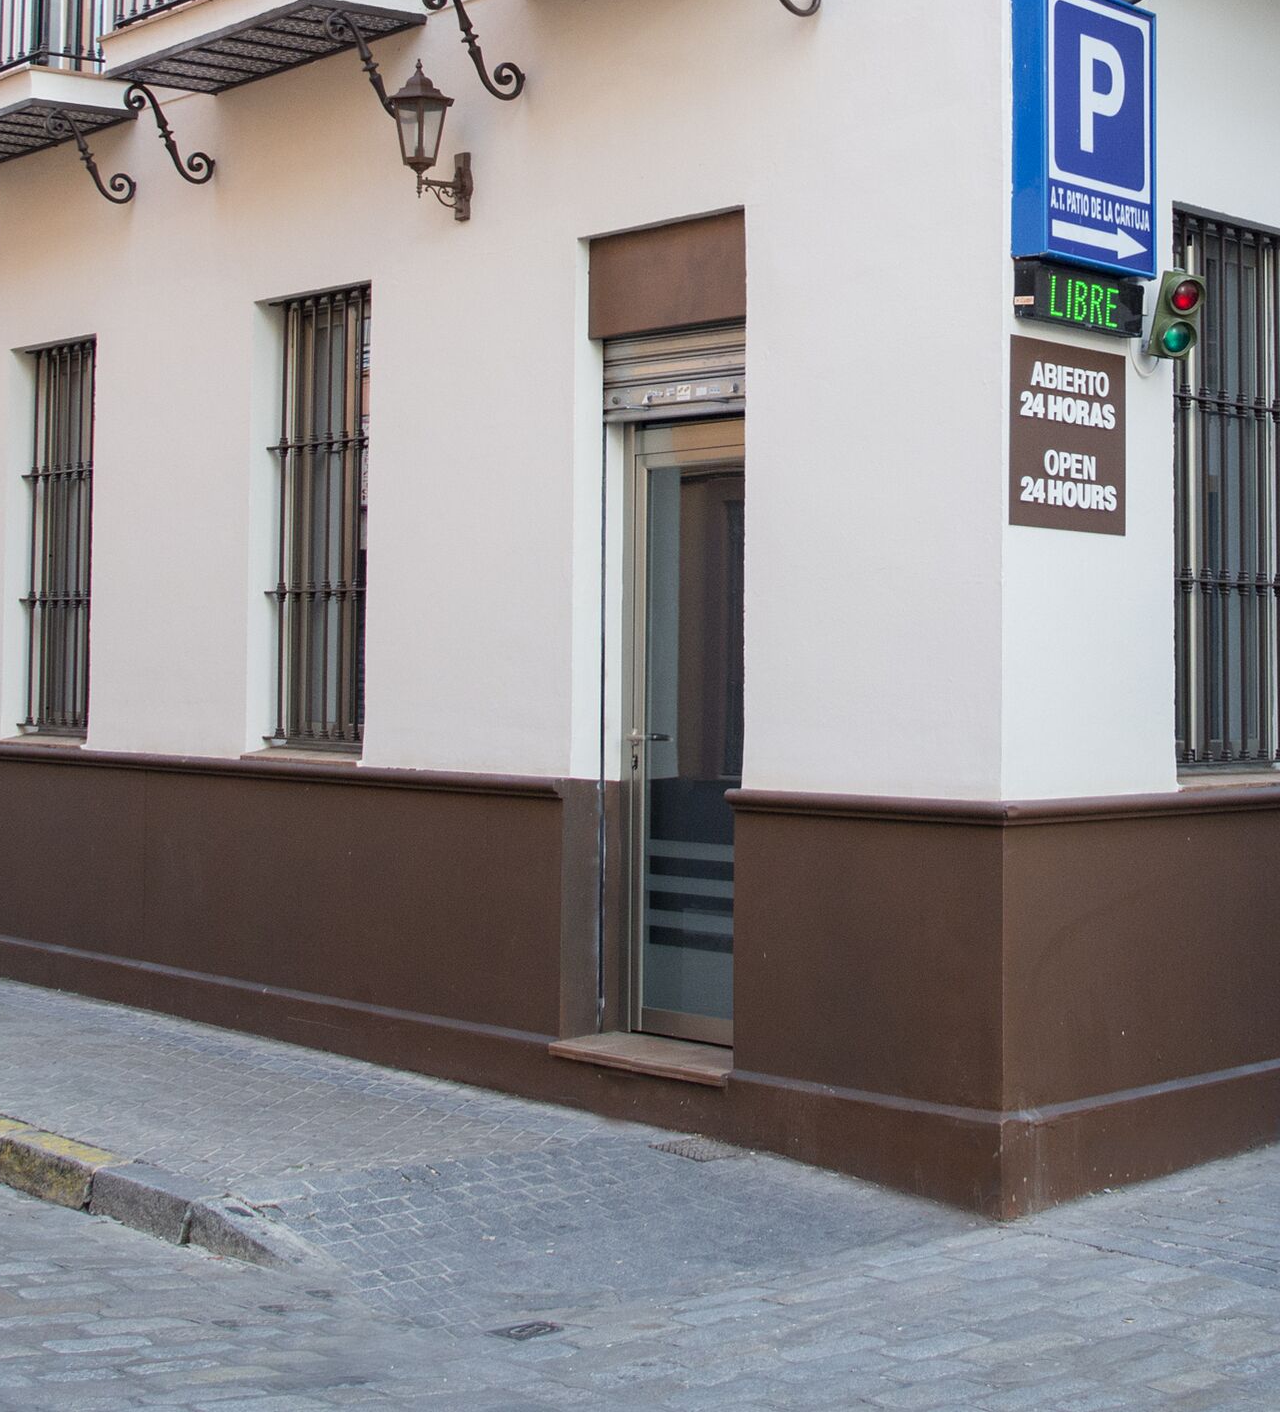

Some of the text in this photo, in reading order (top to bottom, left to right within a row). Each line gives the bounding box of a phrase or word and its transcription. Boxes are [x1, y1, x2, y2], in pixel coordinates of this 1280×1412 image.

[1080, 33, 1125, 153] P
[1050, 185, 1151, 232] A.T. PATIO DE LA CARTUJA
[1050, 275, 1120, 328] LIBRE
[1030, 361, 1110, 398] ABIERTO
[1020, 391, 1116, 430] 24 HORAS
[1044, 449, 1097, 481] OPEN
[1020, 475, 1117, 512] 24 HOURS
